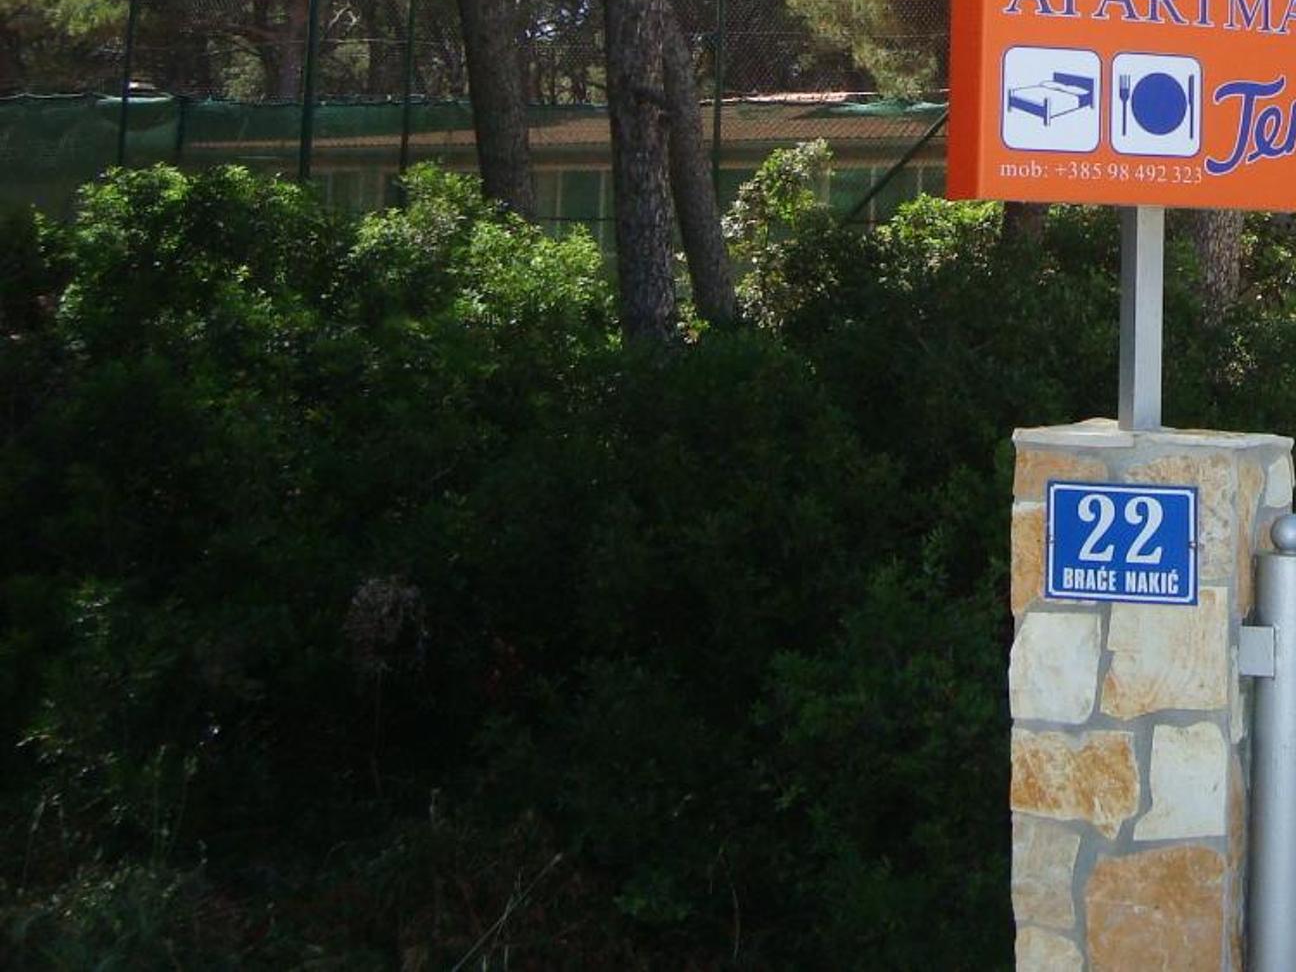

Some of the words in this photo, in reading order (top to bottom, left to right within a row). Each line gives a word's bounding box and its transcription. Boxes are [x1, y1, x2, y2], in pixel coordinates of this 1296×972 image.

[1000, 159, 1049, 179] mob:
[1055, 161, 1102, 181] +385
[1107, 162, 1130, 182] 98
[1135, 165, 1168, 184] 492
[1078, 494, 1163, 564] 22
[1063, 566, 1117, 592] BRAĆE
[1125, 569, 1179, 595] NAKIĆ
